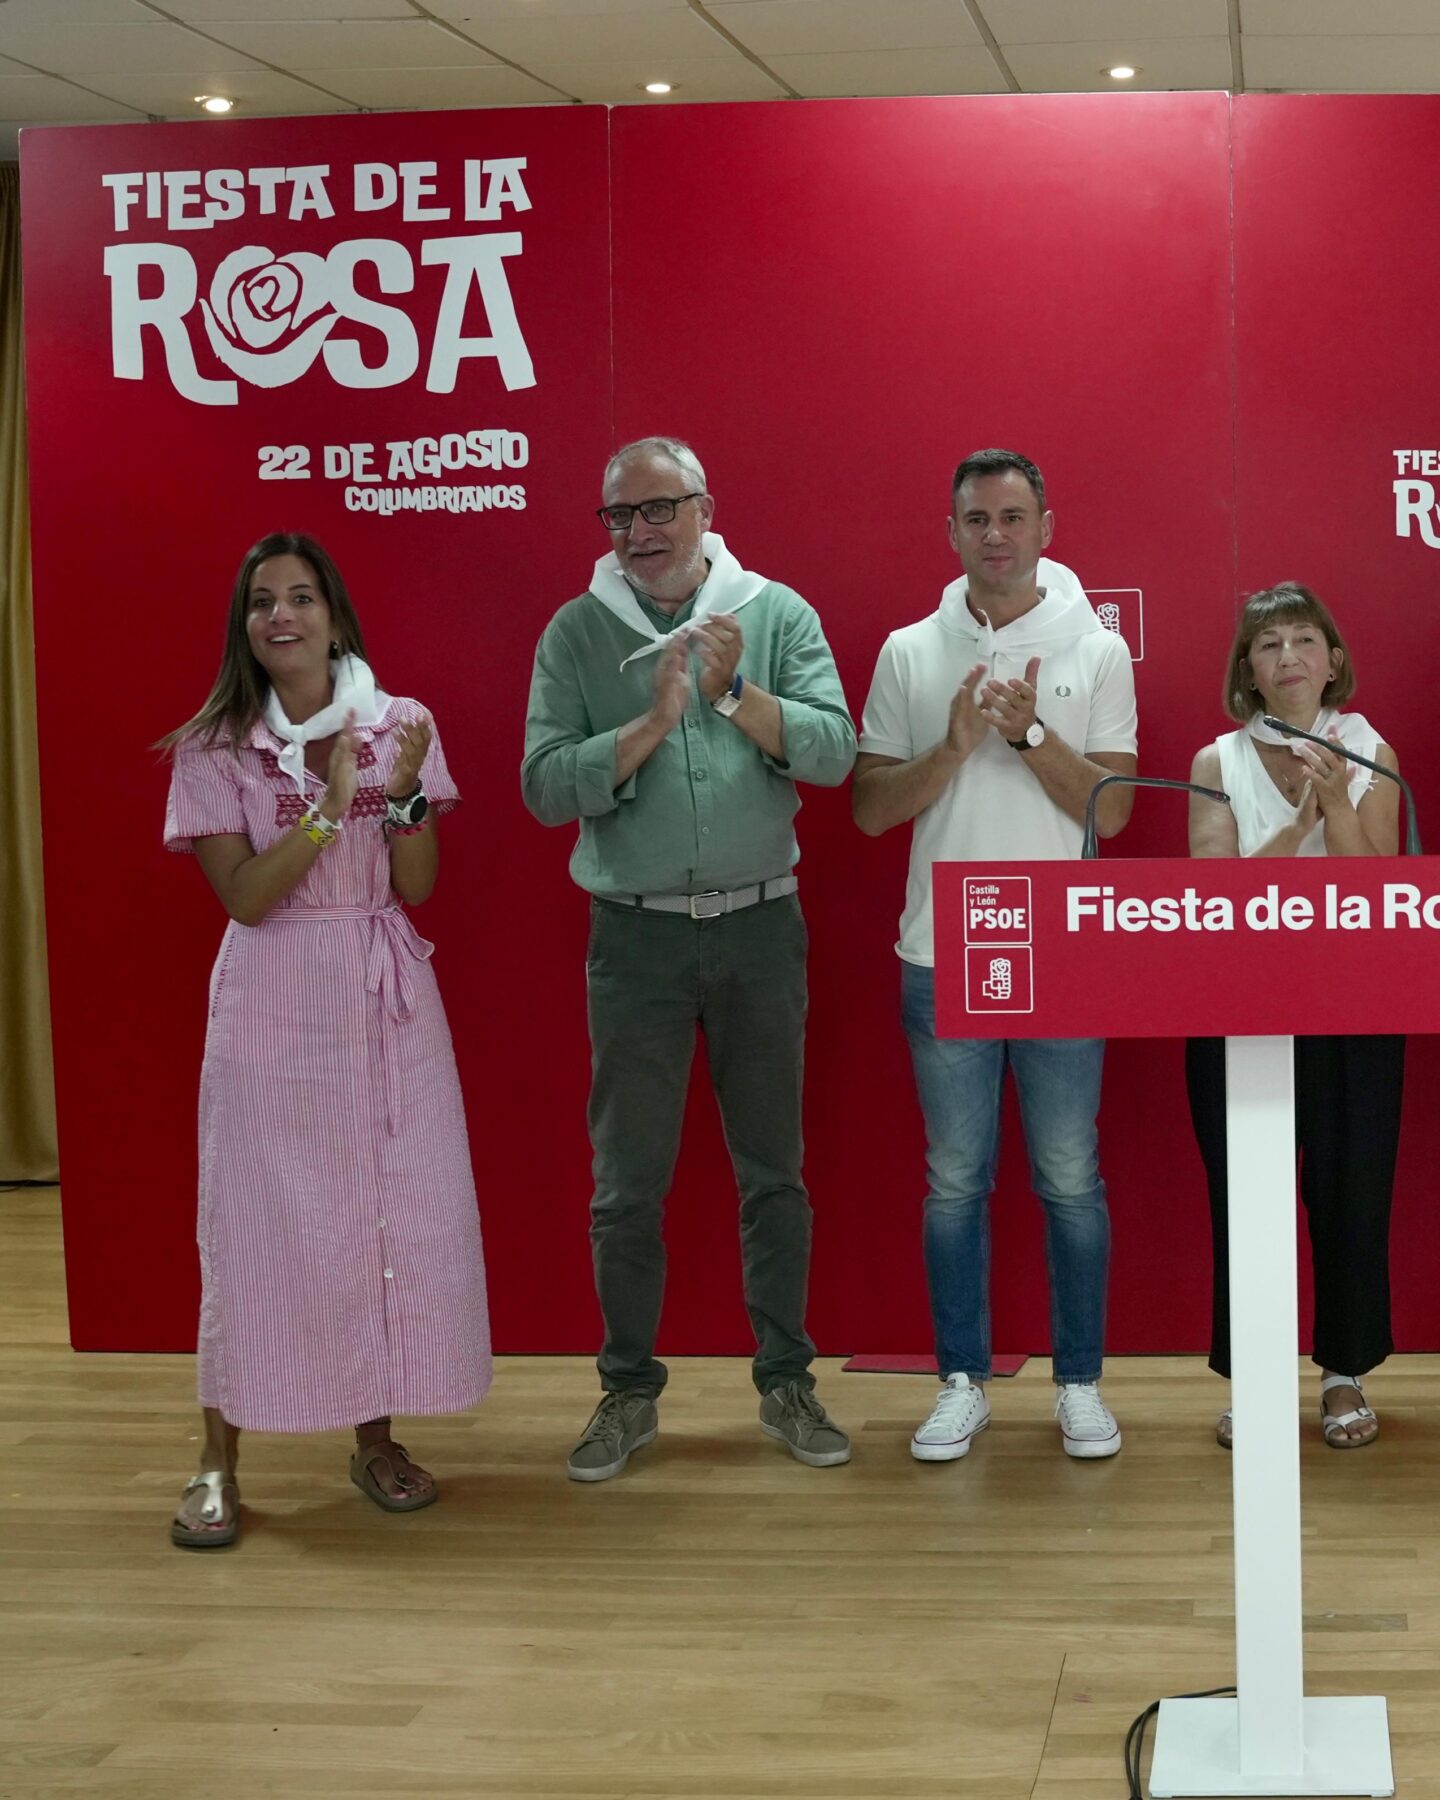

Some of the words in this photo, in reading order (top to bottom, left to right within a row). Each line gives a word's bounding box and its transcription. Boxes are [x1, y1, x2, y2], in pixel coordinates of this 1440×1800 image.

[102, 165, 335, 231] FIESTA
[354, 161, 451, 222] DE
[464, 157, 533, 221] LA
[104, 231, 537, 405] ROSA
[257, 445, 311, 480] 22
[323, 443, 382, 482] DE
[386, 429, 529, 481] AGOSTO
[344, 485, 526, 515] COLUMBRIANOS
[969, 884, 1000, 895] Castilla
[969, 898, 975, 908] y
[976, 896, 997, 906] León
[1066, 886, 1234, 932] Fiesta
[1245, 885, 1315, 931] de
[1326, 884, 1371, 930] la
[970, 908, 1026, 929] PSOE
